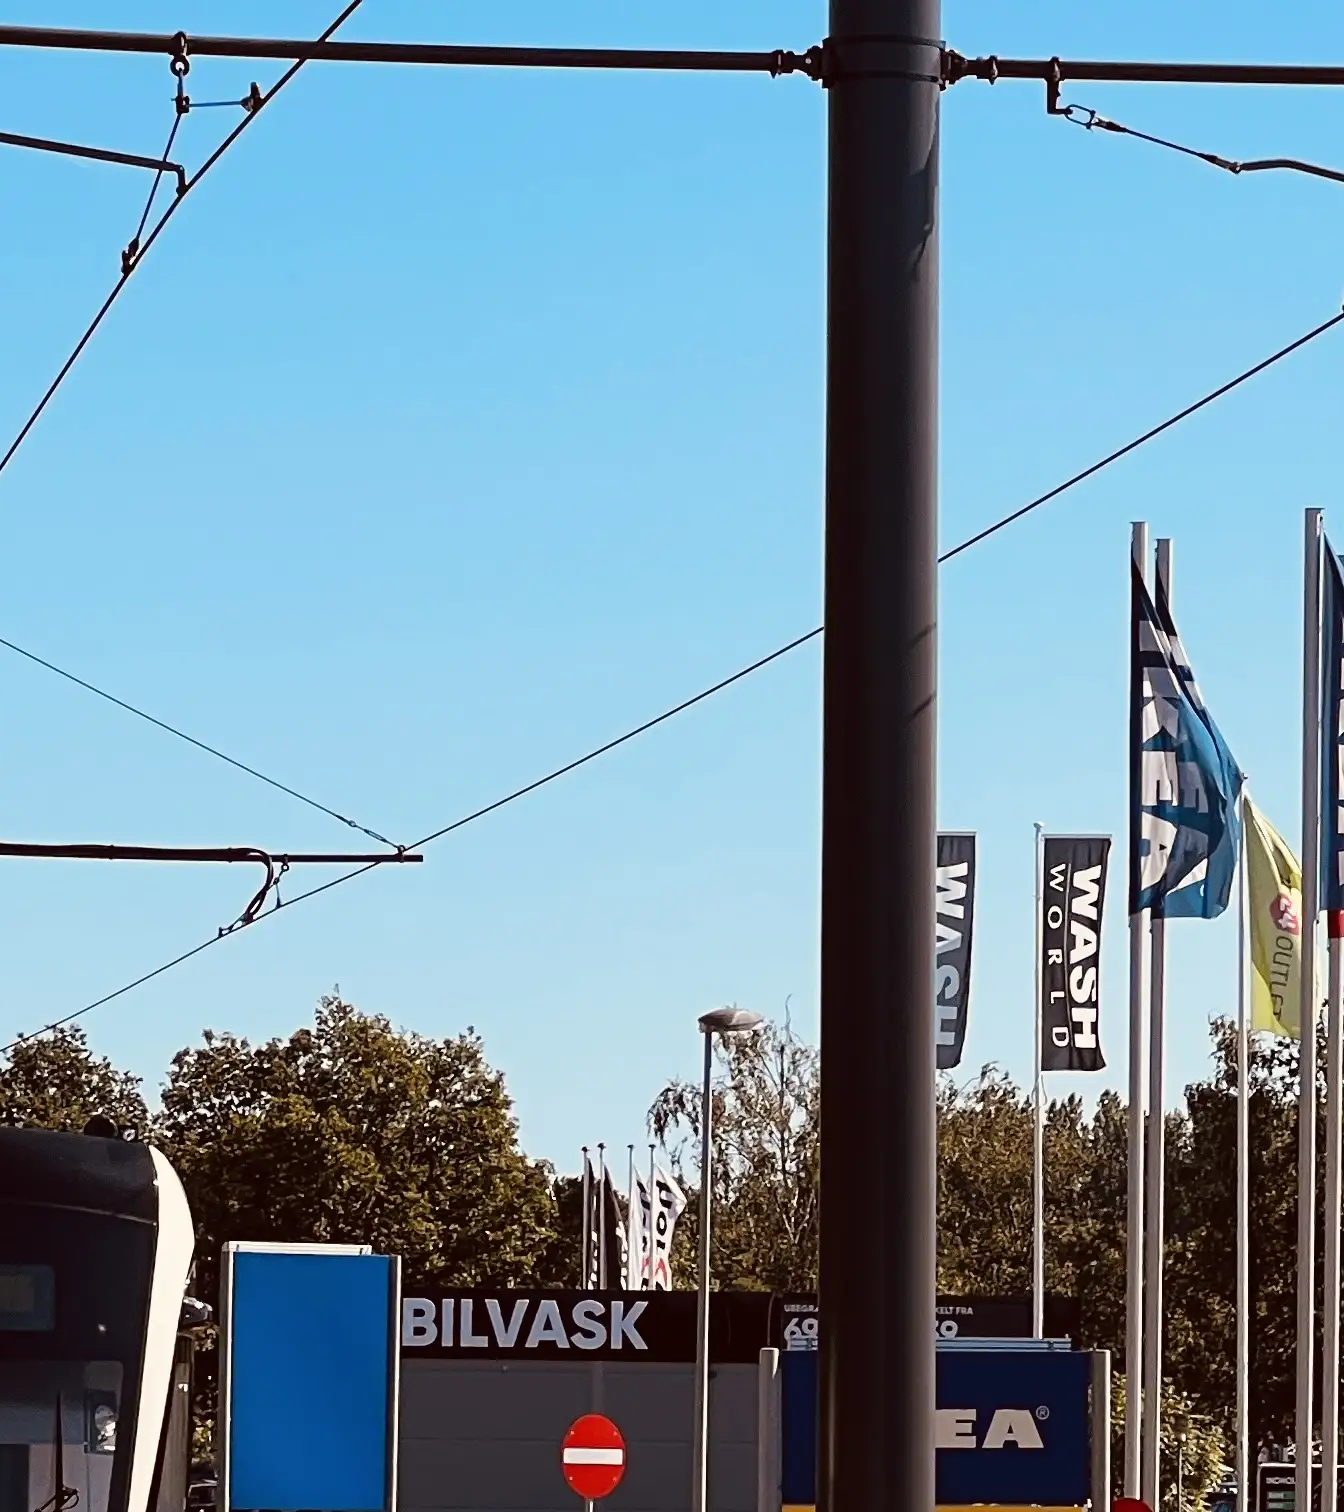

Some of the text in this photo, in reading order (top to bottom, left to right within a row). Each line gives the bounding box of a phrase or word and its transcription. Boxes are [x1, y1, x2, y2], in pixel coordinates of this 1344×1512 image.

[1047, 864, 1070, 1047] WORLD
[1069, 865, 1102, 1048] WASH
[401, 1297, 649, 1350] BILVASK
